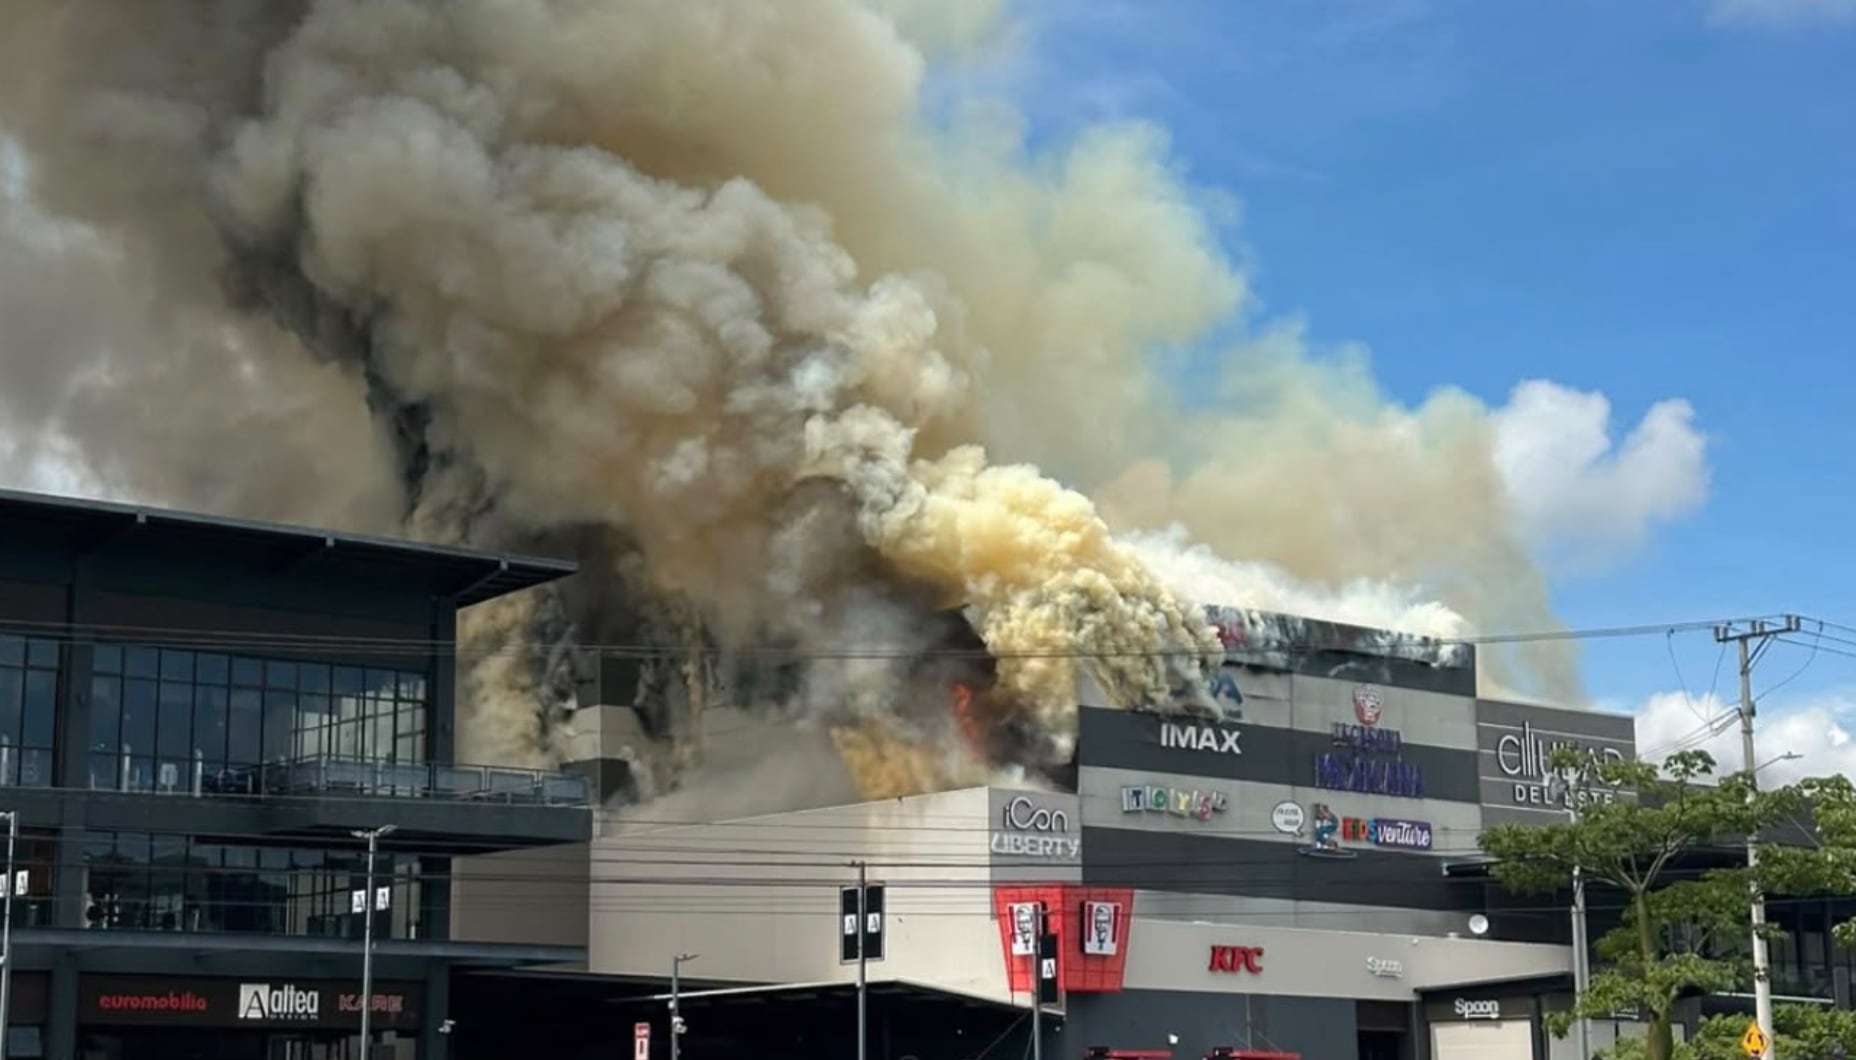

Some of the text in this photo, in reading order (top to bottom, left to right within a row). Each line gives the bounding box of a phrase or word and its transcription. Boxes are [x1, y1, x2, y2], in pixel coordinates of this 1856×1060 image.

[1161, 723, 1242, 755] IMAX
[1515, 784, 1553, 805] DEL
[992, 833, 1079, 857] LIBERTY
[1208, 945, 1264, 974] KFC
[100, 990, 206, 1010] euromobilia
[271, 984, 319, 1013] altea
[1455, 998, 1499, 1018] Spoon
